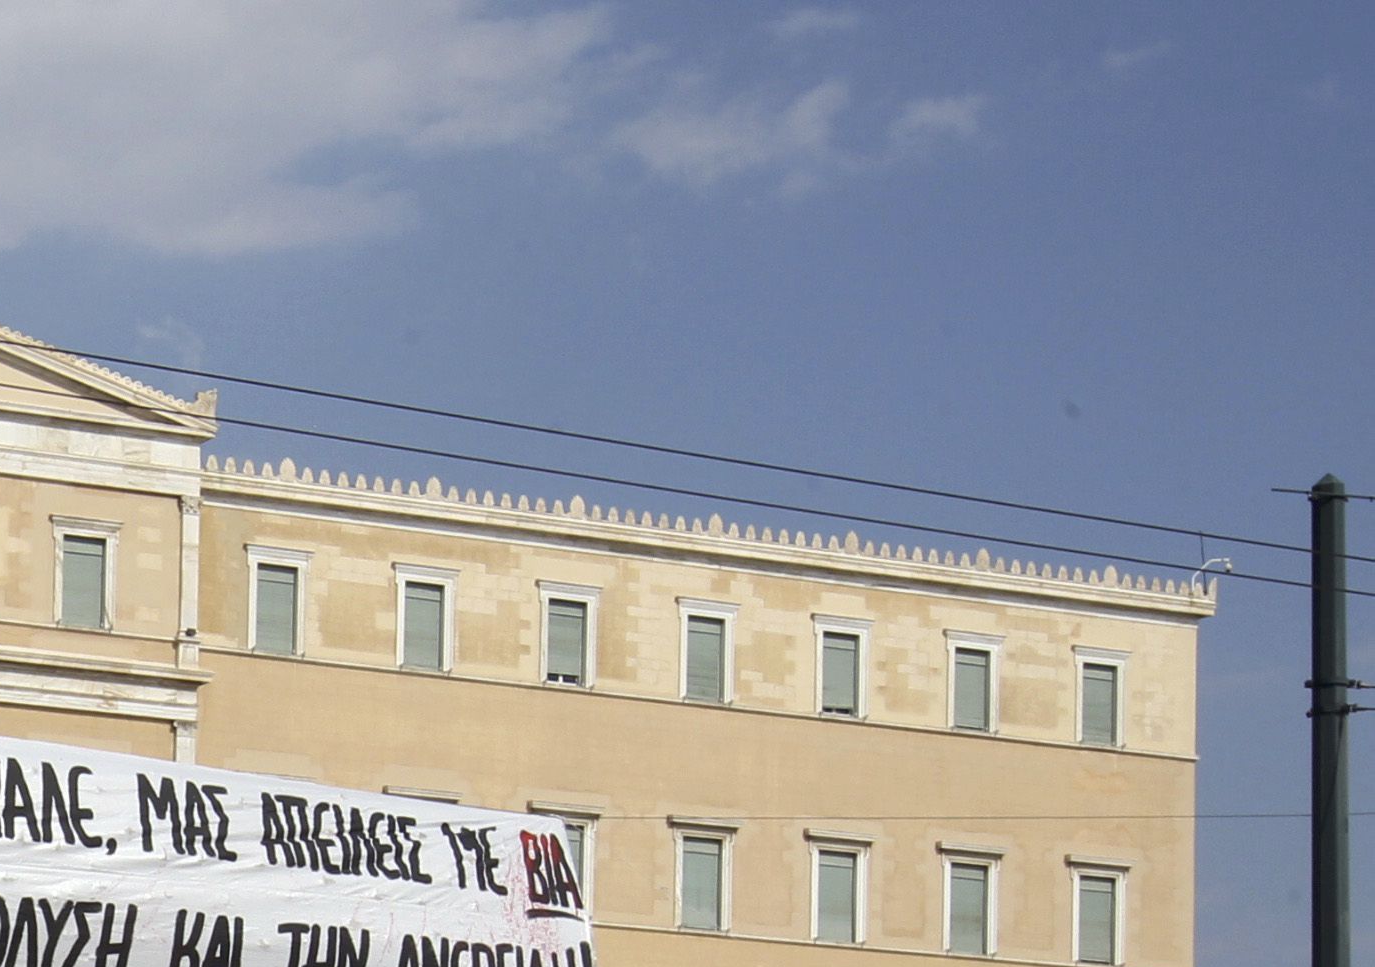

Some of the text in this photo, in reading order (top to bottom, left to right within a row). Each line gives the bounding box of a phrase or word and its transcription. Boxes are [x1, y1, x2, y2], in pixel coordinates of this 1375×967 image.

[137, 773, 238, 862] ΜΑΣ
[261, 792, 433, 885] ΑΠΕΙΛΕΙΣ
[441, 822, 509, 896] ΜΕ
[519, 830, 583, 910] ΒΙΑ
